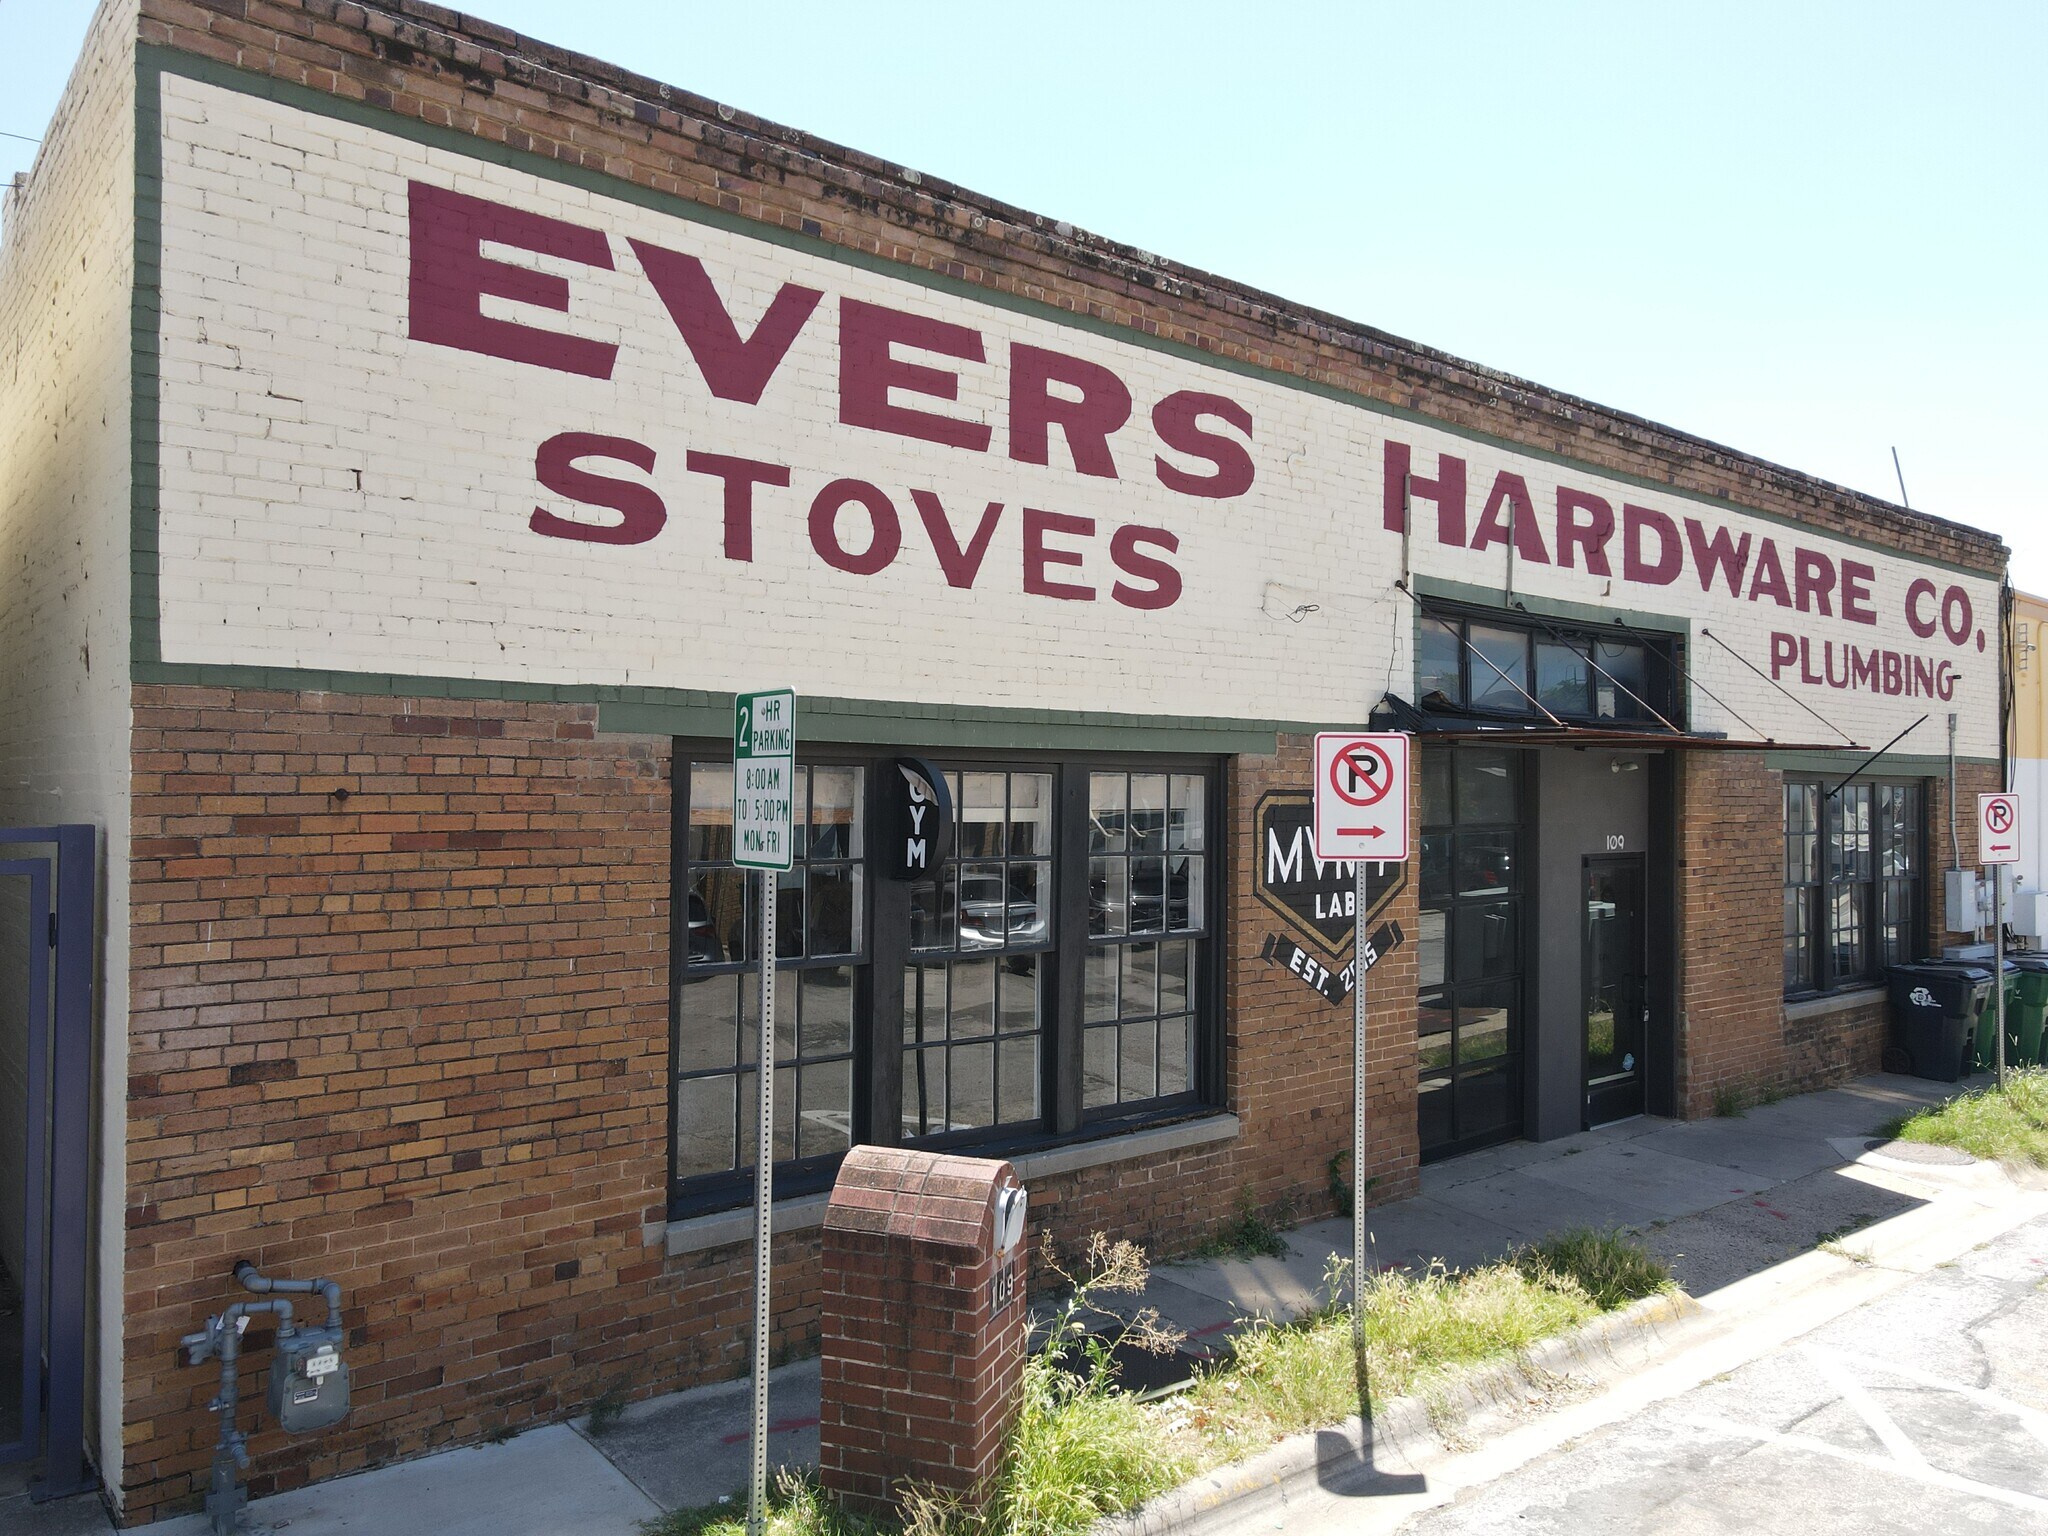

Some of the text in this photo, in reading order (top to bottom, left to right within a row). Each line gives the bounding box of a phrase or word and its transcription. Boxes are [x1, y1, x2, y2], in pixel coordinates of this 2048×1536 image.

[408, 180, 1255, 498] EVERS
[529, 431, 1182, 610] STOVES
[1383, 440, 1985, 653] HARDWARE CO.
[1771, 631, 1955, 702] PLUMBING
[739, 700, 780, 747] 2 HR
[753, 728, 790, 751] PARKING
[738, 799, 747, 820] TO
[1606, 834, 1625, 850] 109
[1315, 891, 1355, 919] LAB
[1290, 947, 1330, 996] EST.
